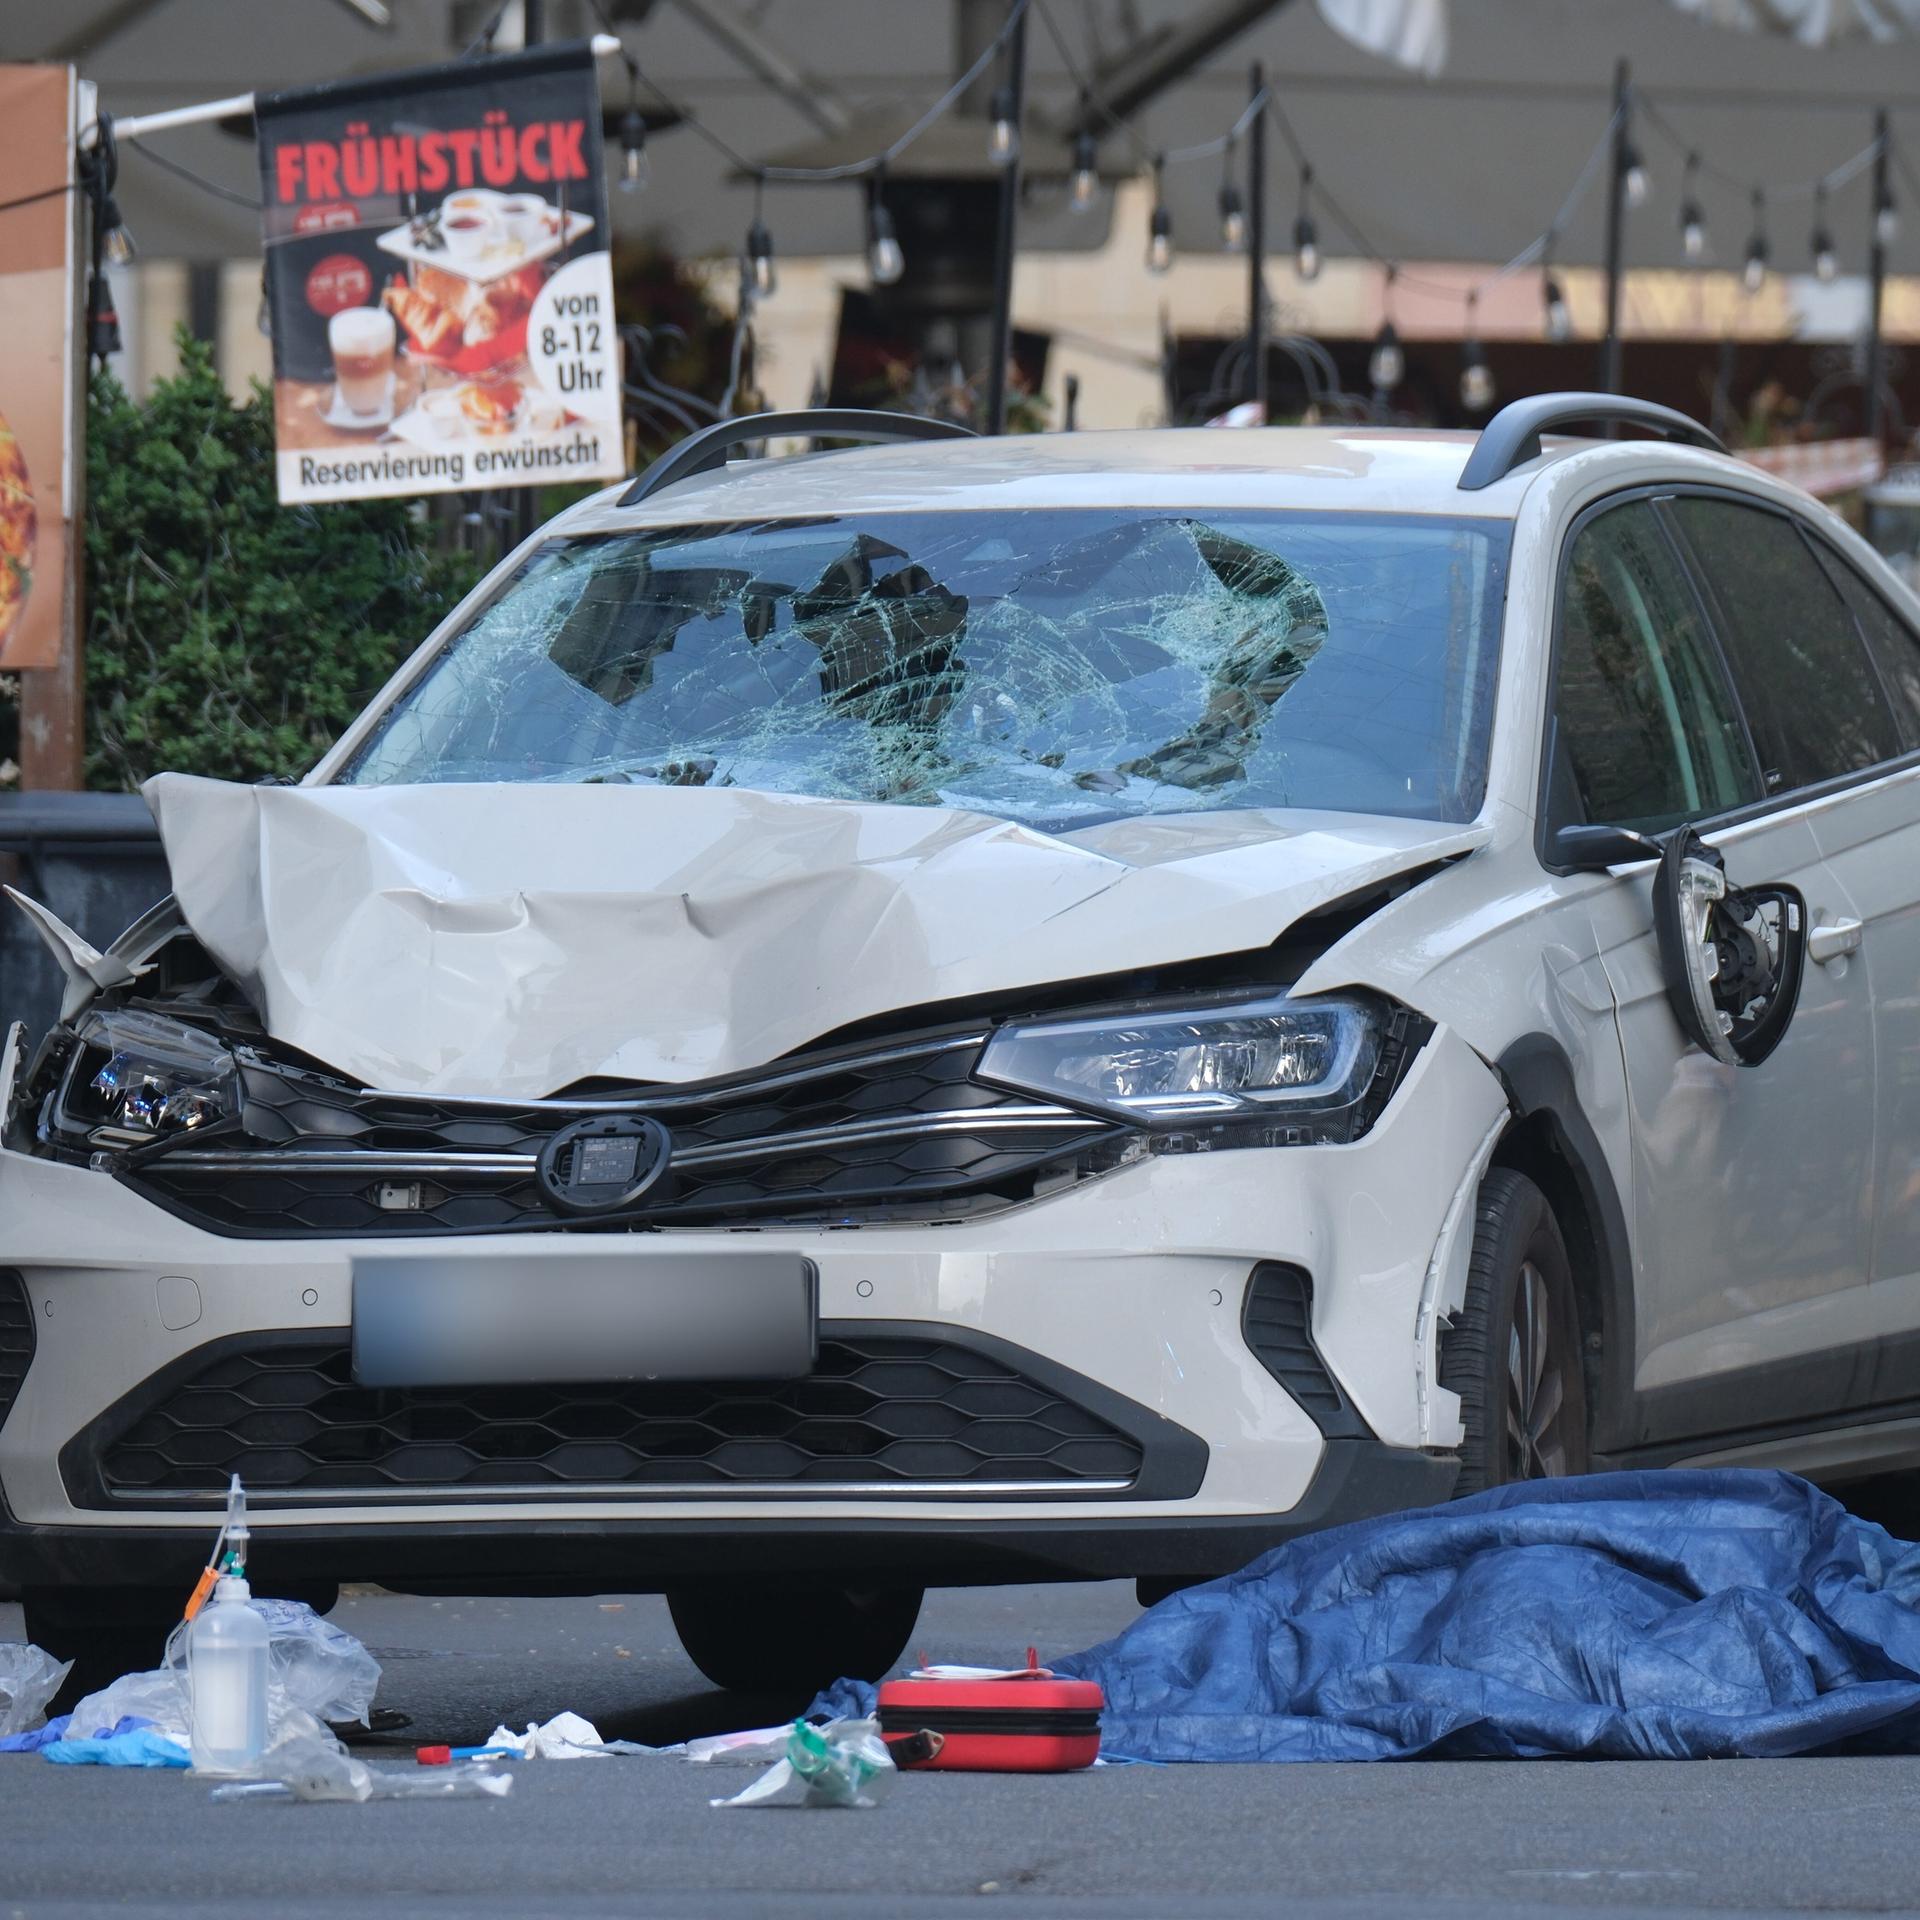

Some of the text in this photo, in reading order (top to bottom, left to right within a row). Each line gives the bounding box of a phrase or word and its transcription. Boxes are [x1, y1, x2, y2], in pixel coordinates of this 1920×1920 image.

[277, 111, 588, 202] FRÜHSTÜCK
[553, 295, 599, 316] von
[542, 322, 600, 356] 8-12
[558, 361, 603, 393] Uhr
[300, 431, 600, 485] Reservierung erwünscht
